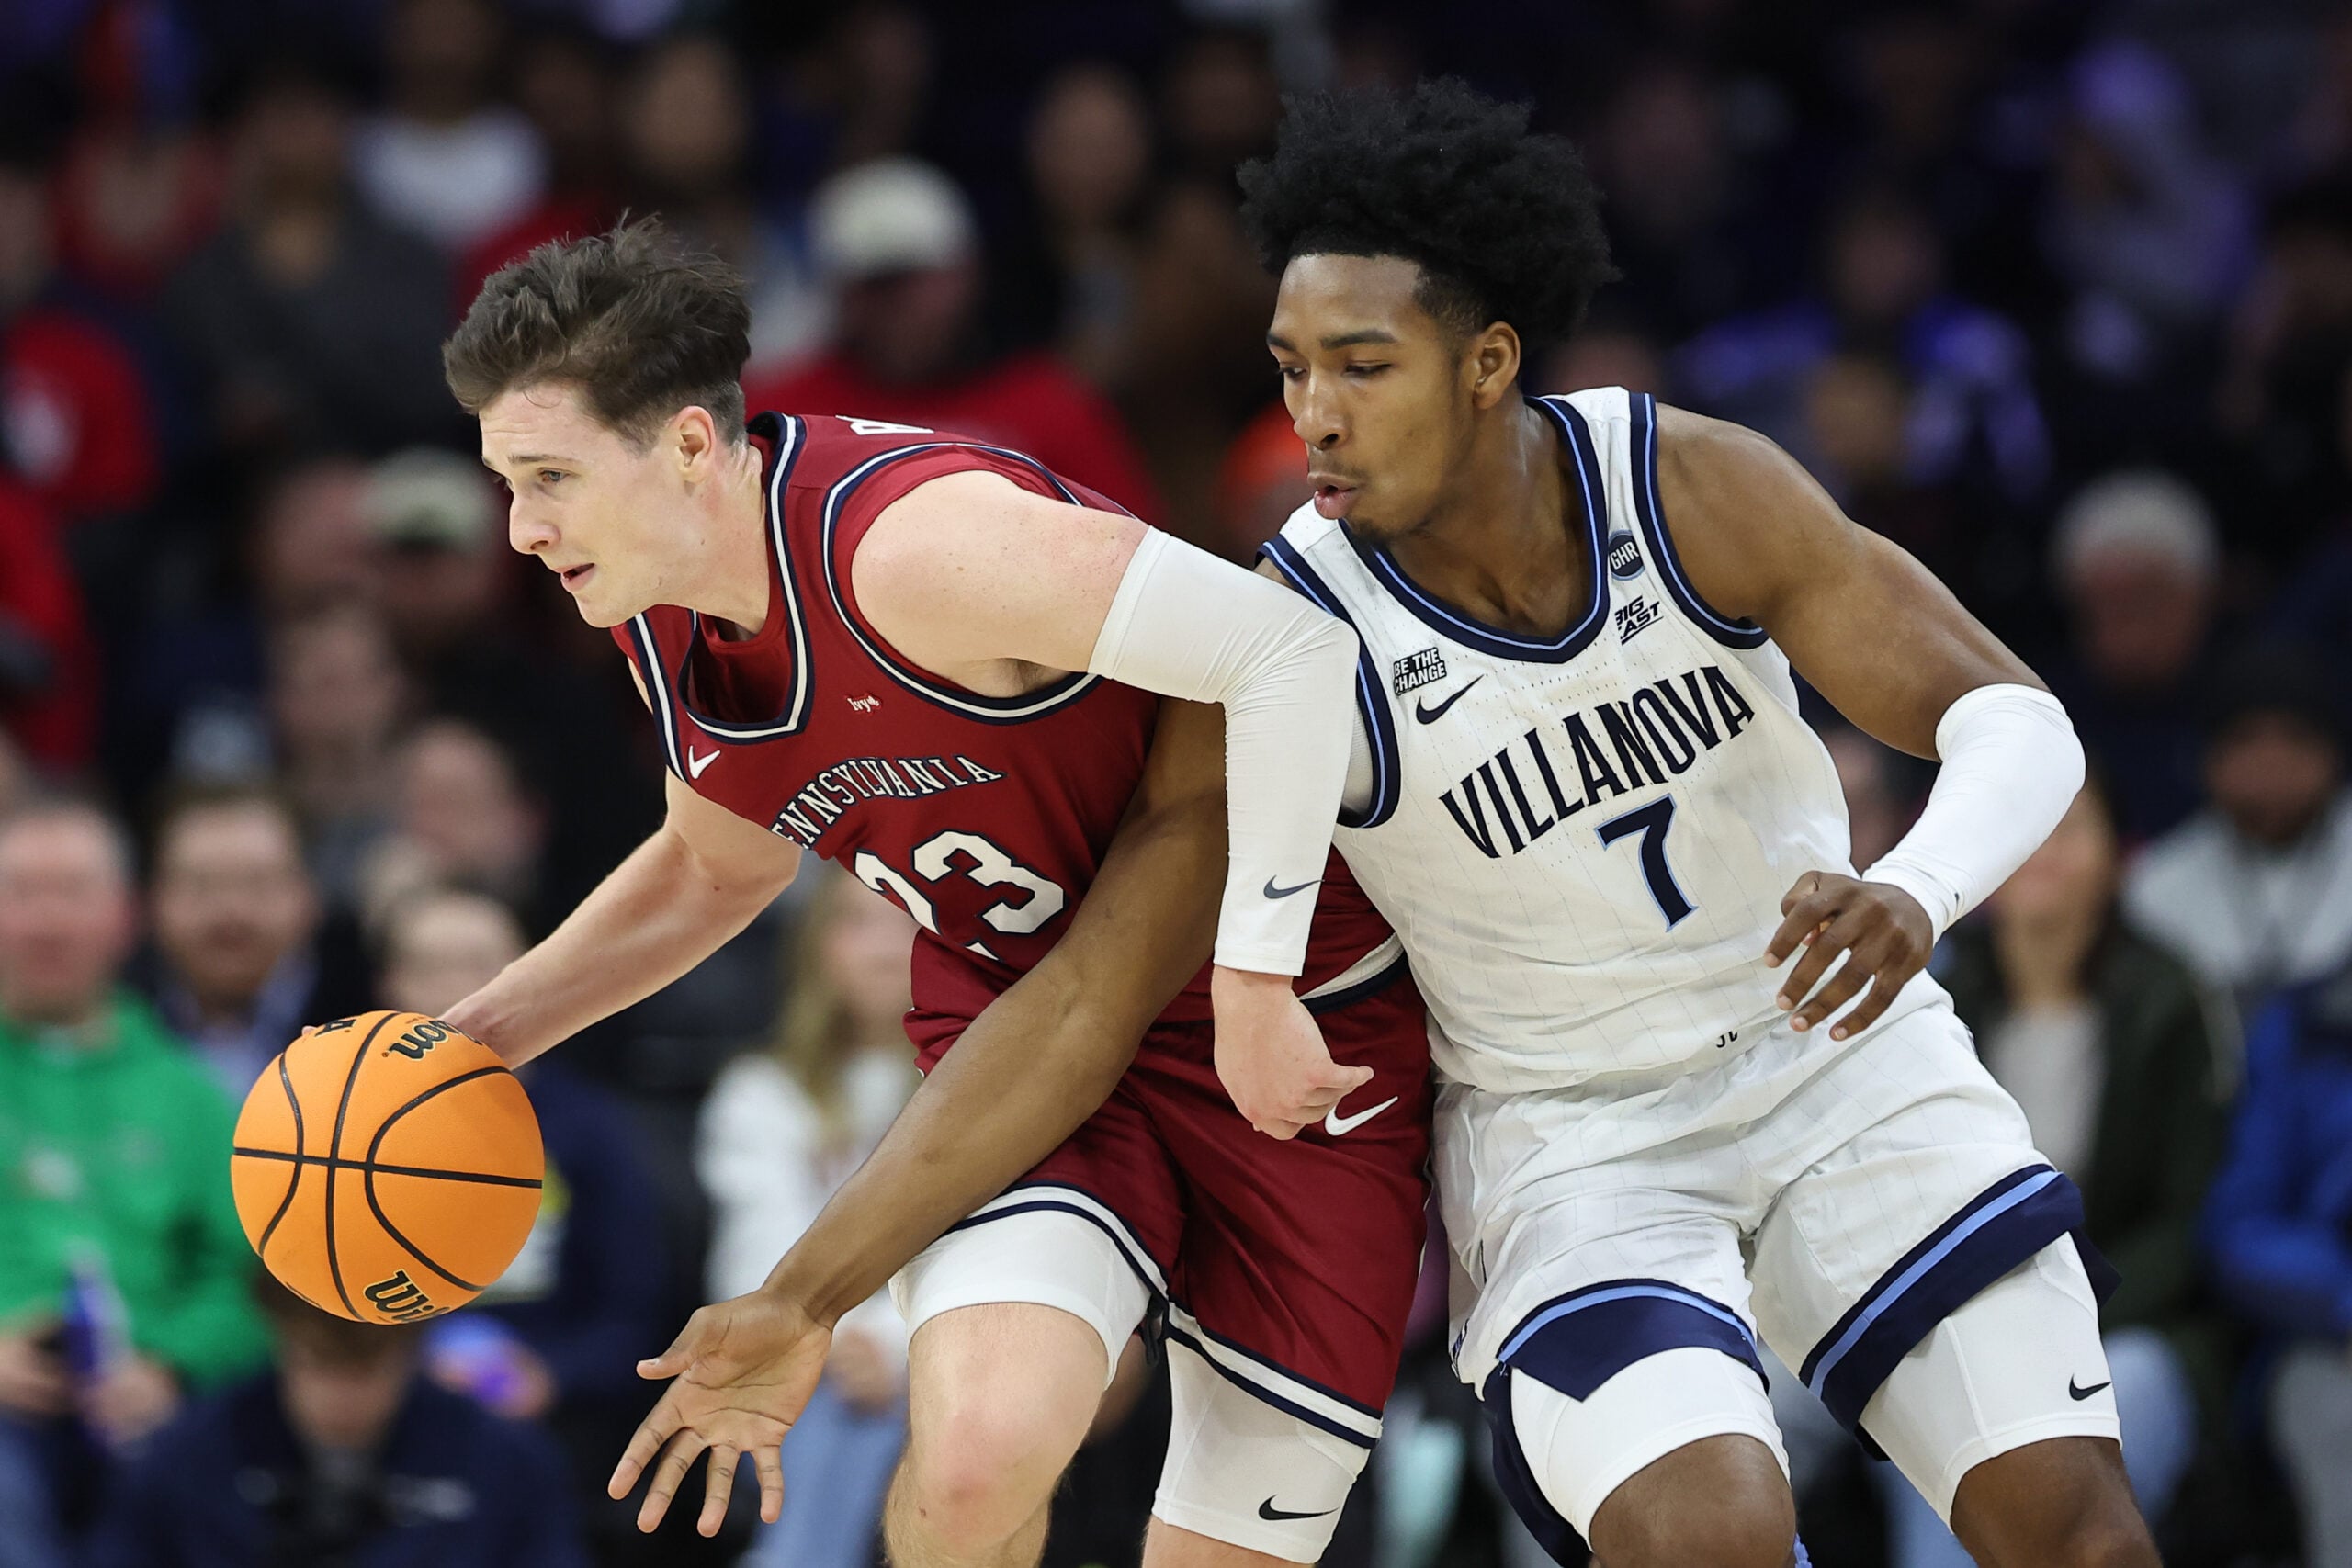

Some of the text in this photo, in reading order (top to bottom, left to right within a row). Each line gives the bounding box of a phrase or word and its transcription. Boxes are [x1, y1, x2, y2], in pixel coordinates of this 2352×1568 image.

[1610, 540, 1640, 570] GHR
[1618, 601, 1661, 640] AST
[1394, 648, 1440, 678] BE THE
[1438, 665, 1756, 859] VILLANOVA
[770, 754, 1004, 851] ENNSYLVANIA
[1594, 792, 1700, 933] 7
